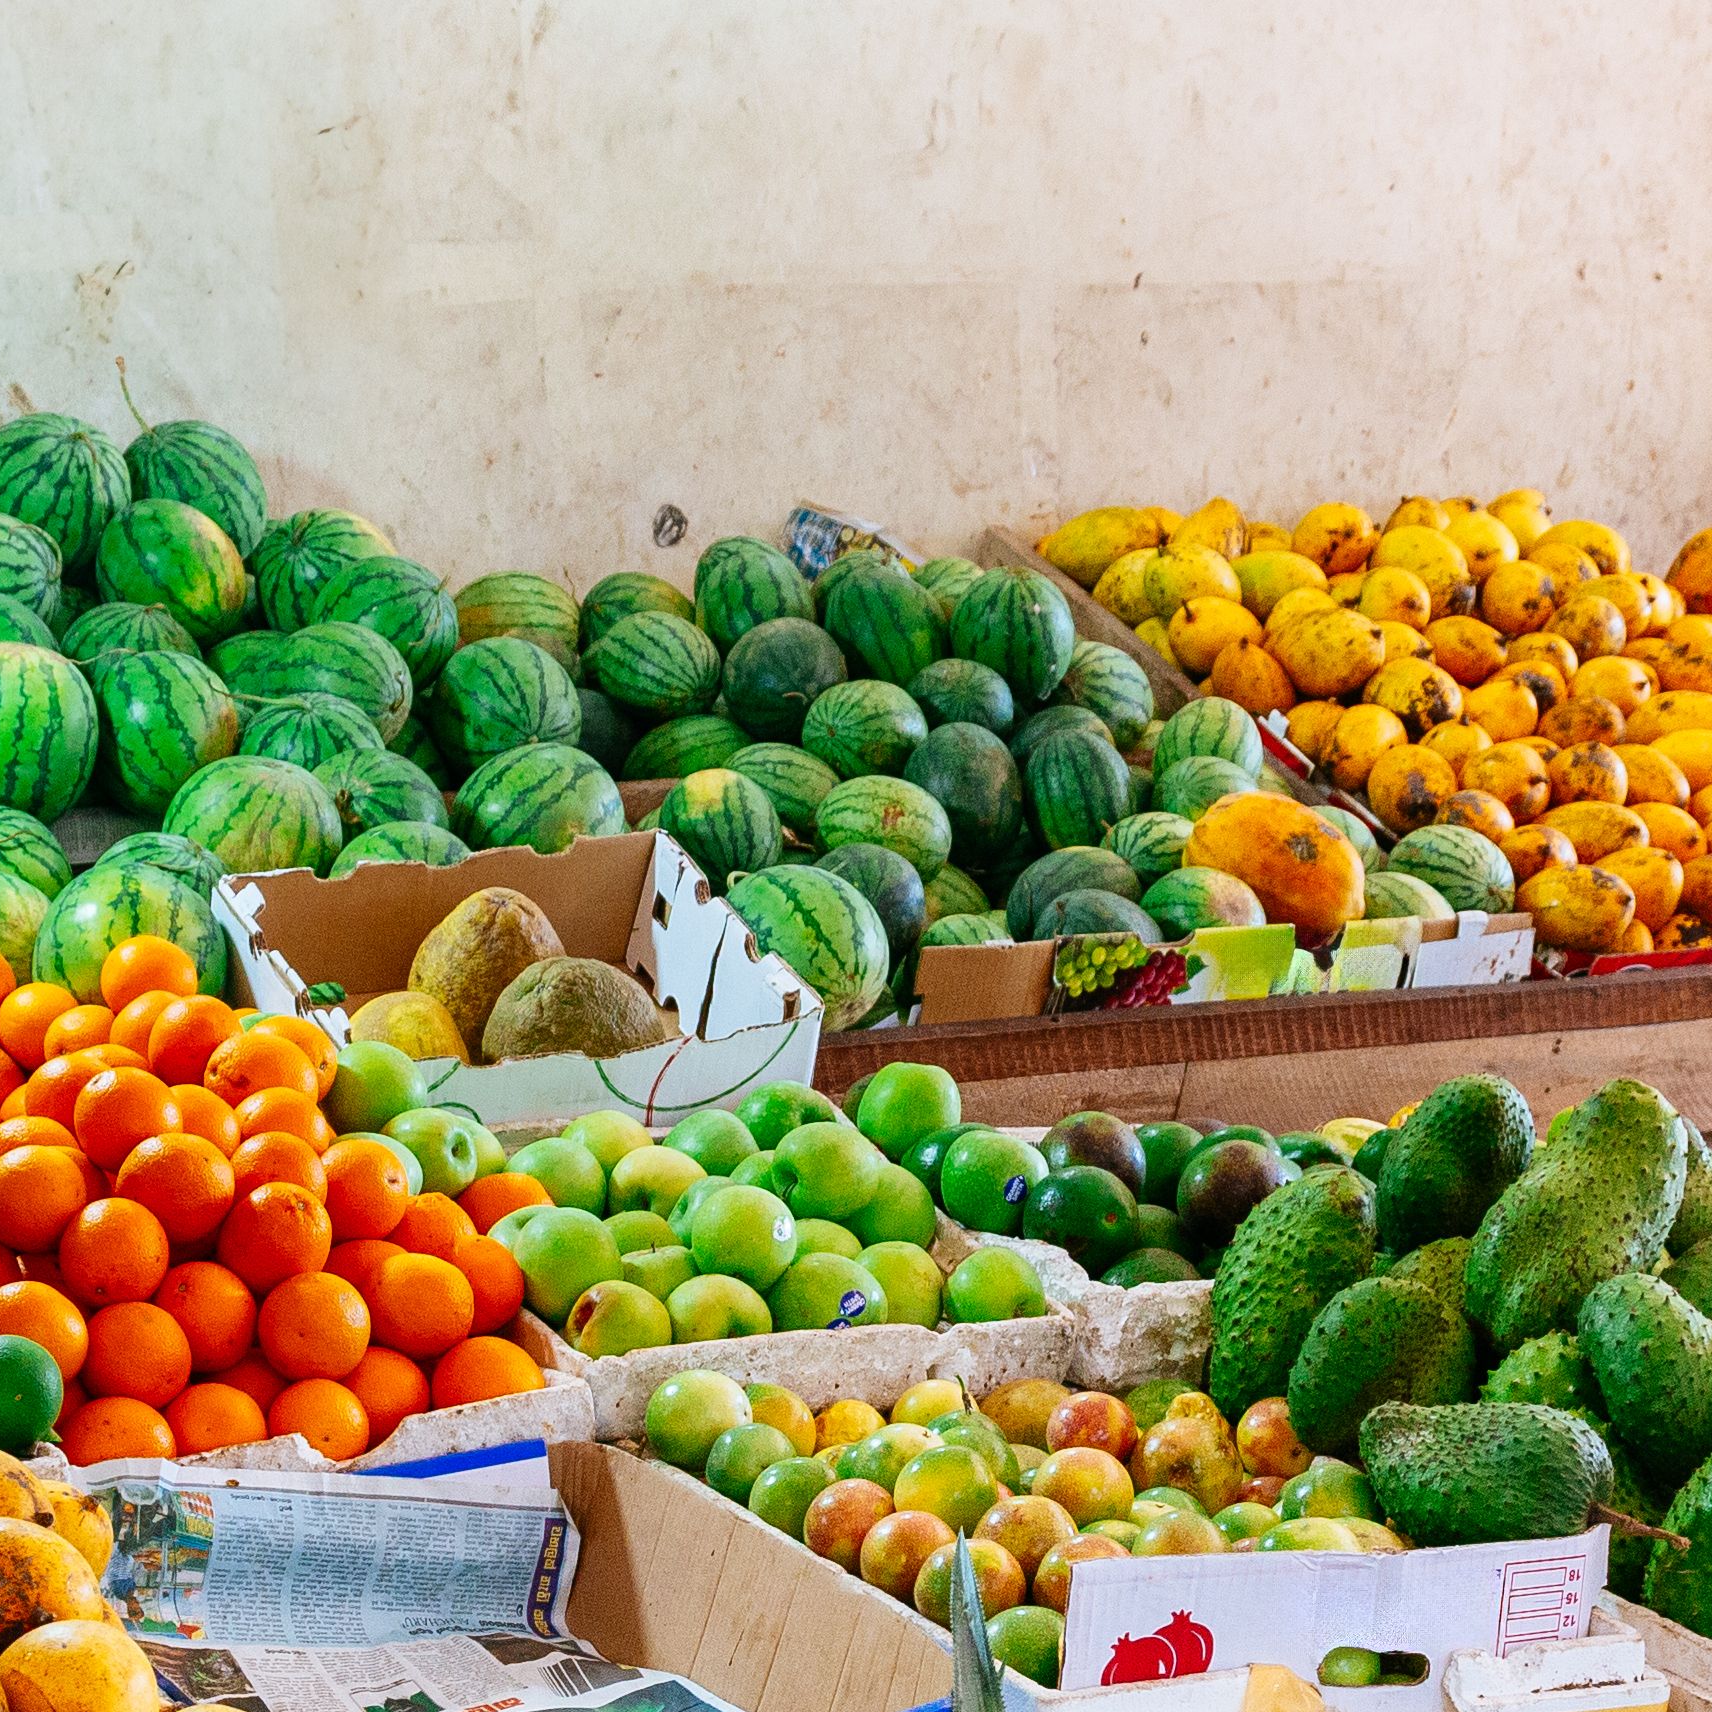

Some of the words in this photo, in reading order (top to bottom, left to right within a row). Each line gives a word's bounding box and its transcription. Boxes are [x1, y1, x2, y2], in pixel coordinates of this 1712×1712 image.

[1568, 1569, 1581, 1581] 18
[1565, 1592, 1579, 1605] 15
[1562, 1615, 1576, 1627] 12
